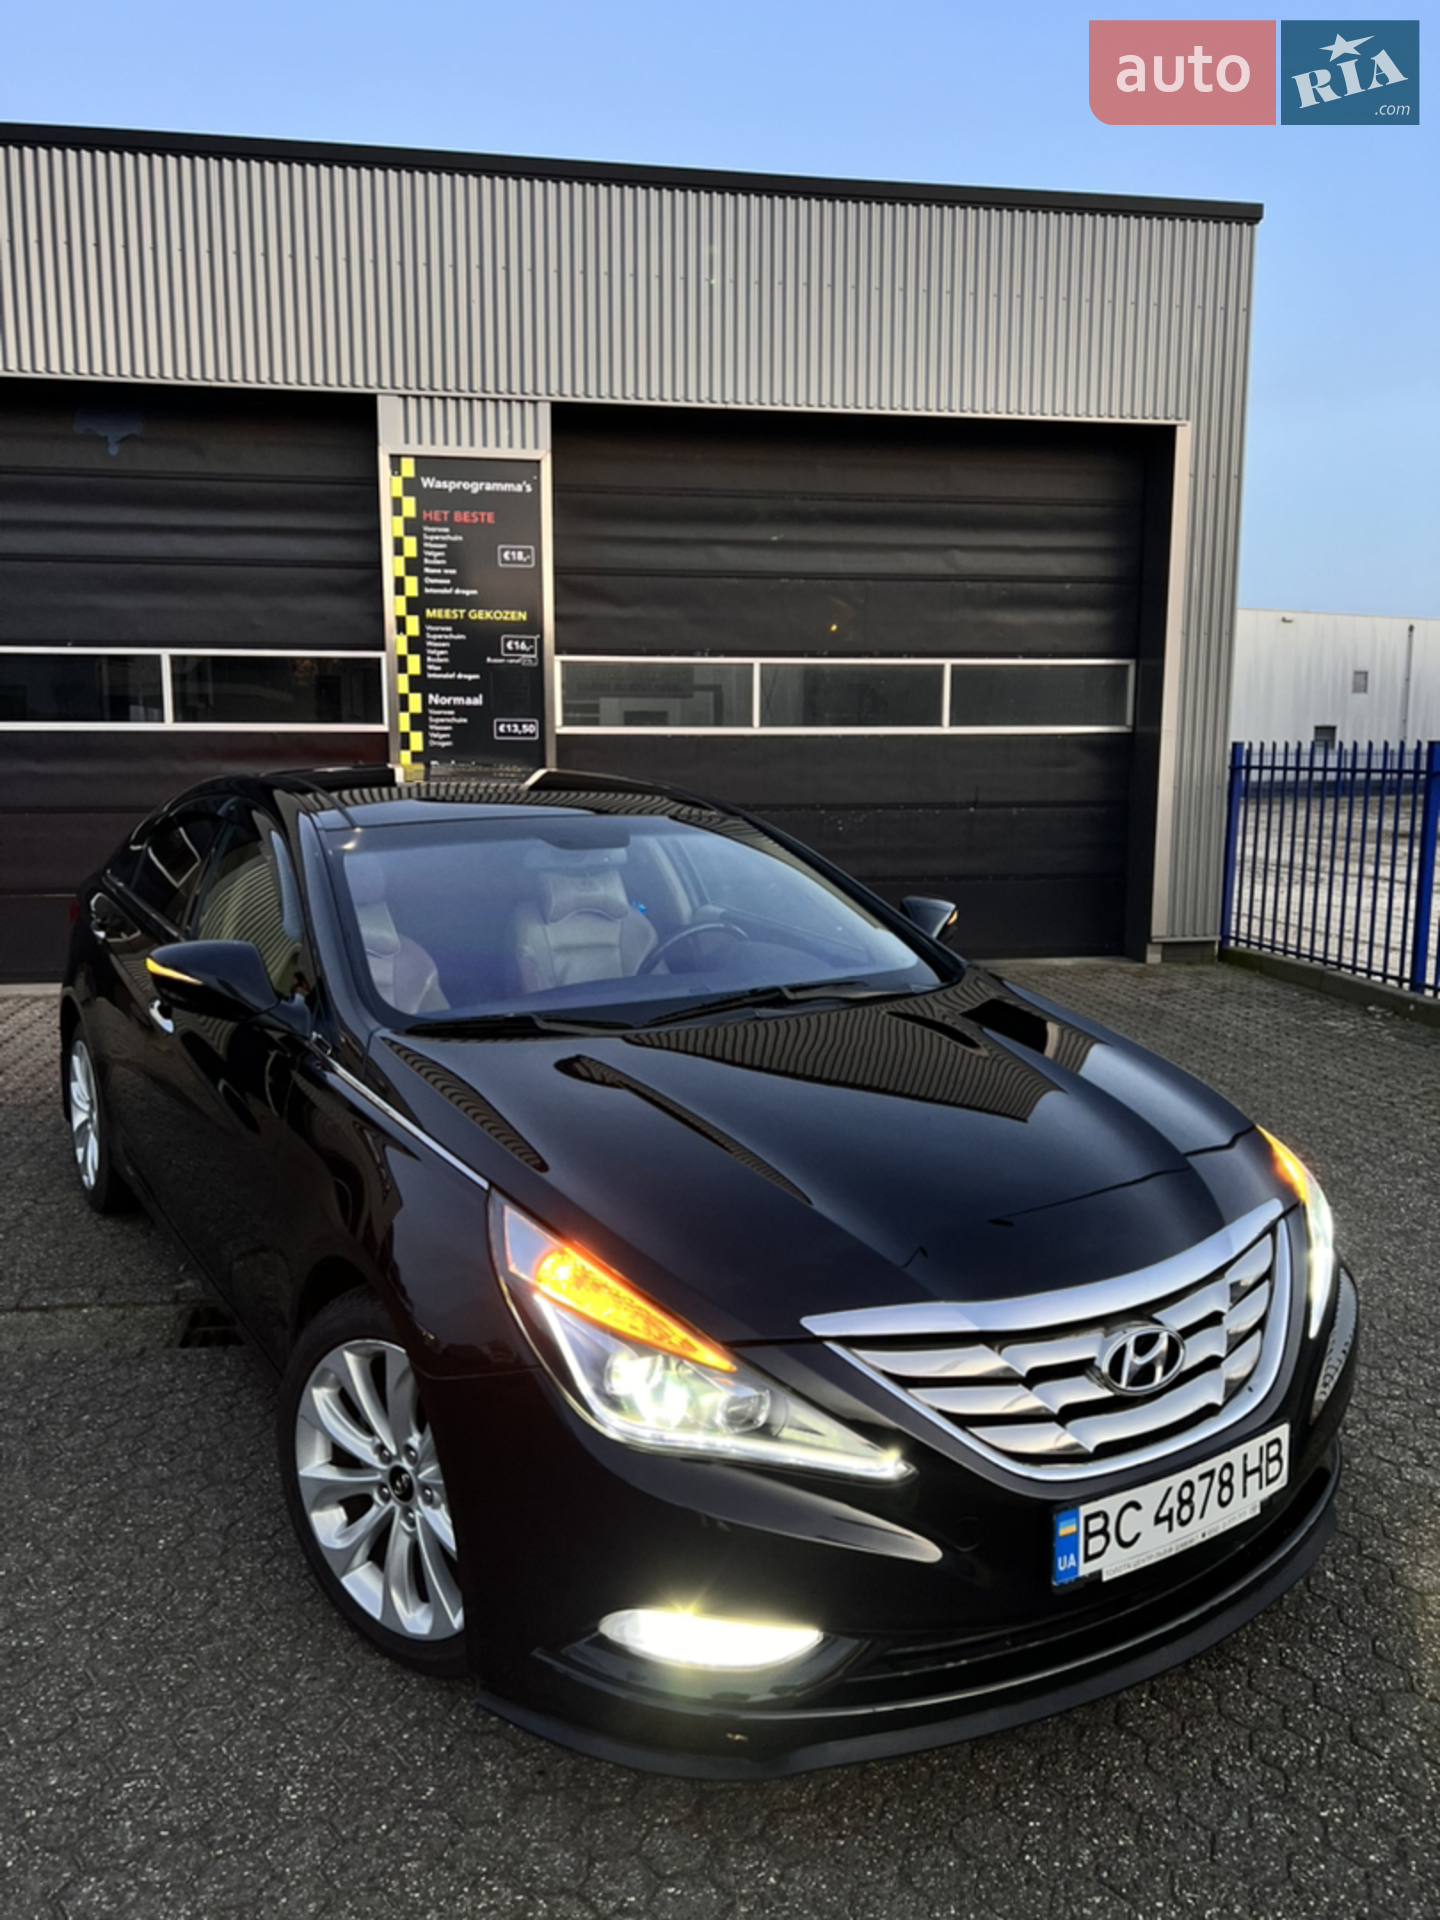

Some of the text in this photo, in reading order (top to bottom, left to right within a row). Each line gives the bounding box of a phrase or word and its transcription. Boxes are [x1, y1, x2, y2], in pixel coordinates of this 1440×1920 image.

[421, 476, 532, 493] Wasprogramma's
[423, 510, 495, 523] HET BESTE
[425, 608, 527, 621] MEEST GEKOZEN
[428, 693, 483, 706] Normaal
[1083, 1500, 1143, 1564] BC
[1154, 1462, 1234, 1533] 4878
[1242, 1437, 1284, 1499] HB
[1057, 1556, 1077, 1572] UA
